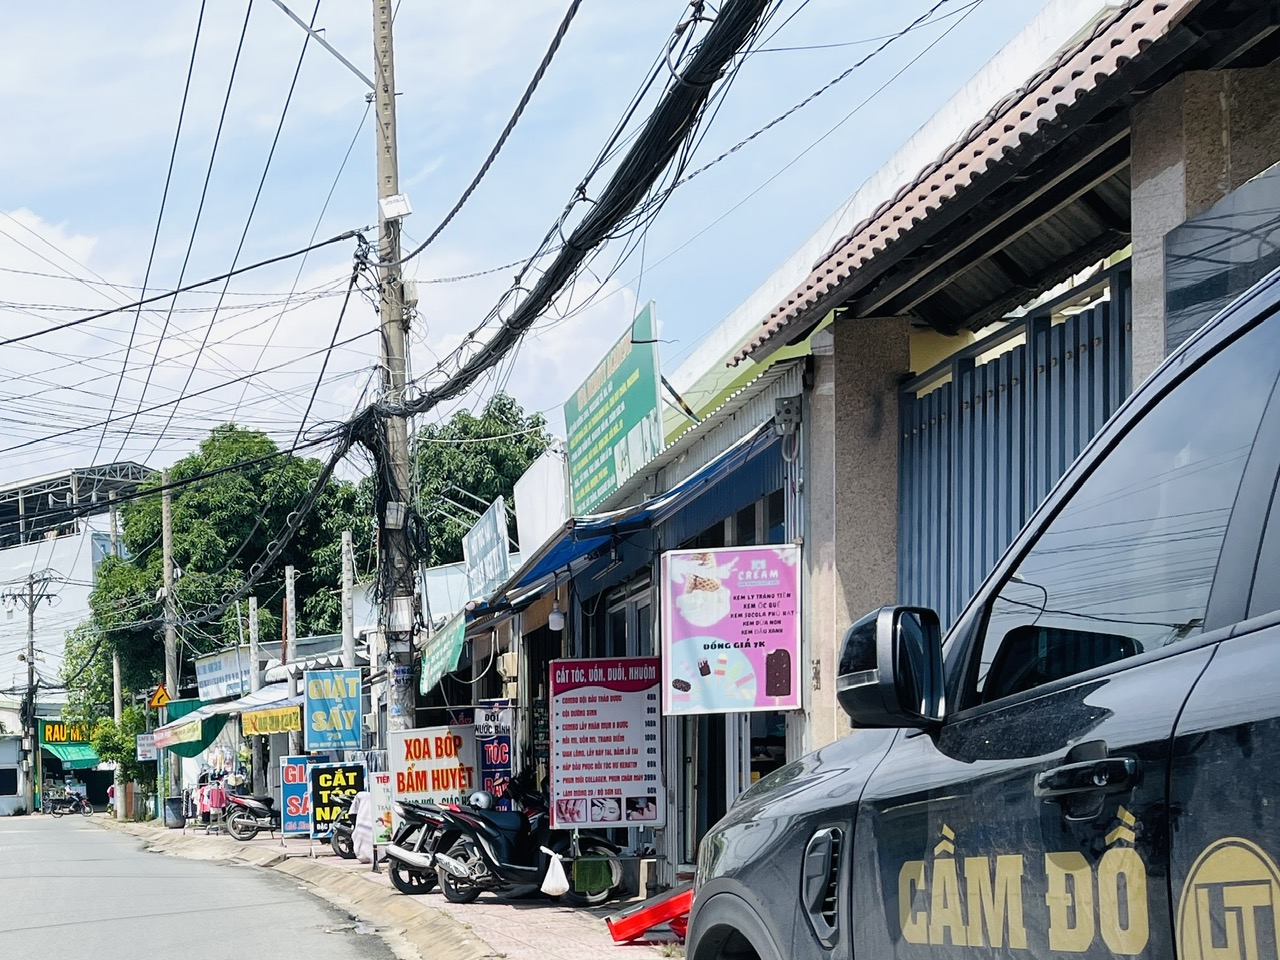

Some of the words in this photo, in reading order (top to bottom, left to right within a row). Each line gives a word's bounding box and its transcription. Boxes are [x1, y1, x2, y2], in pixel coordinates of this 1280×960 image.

[737, 569, 779, 581] CREAM
[733, 638, 751, 649] GIÁ
[753, 640, 766, 648] 7K
[555, 665, 570, 684] CẮT
[628, 664, 656, 683] NHUỘM
[308, 674, 359, 703] GIẶT
[311, 704, 357, 732] SẤY
[45, 724, 67, 742] RAU
[403, 737, 433, 762] XOA
[434, 729, 464, 760] BÓP
[318, 769, 358, 788] CẮT
[396, 763, 428, 794] BẤM
[431, 762, 475, 795] HUYỆT
[898, 823, 1027, 951] CẦM
[1044, 806, 1151, 956] ĐỒ
